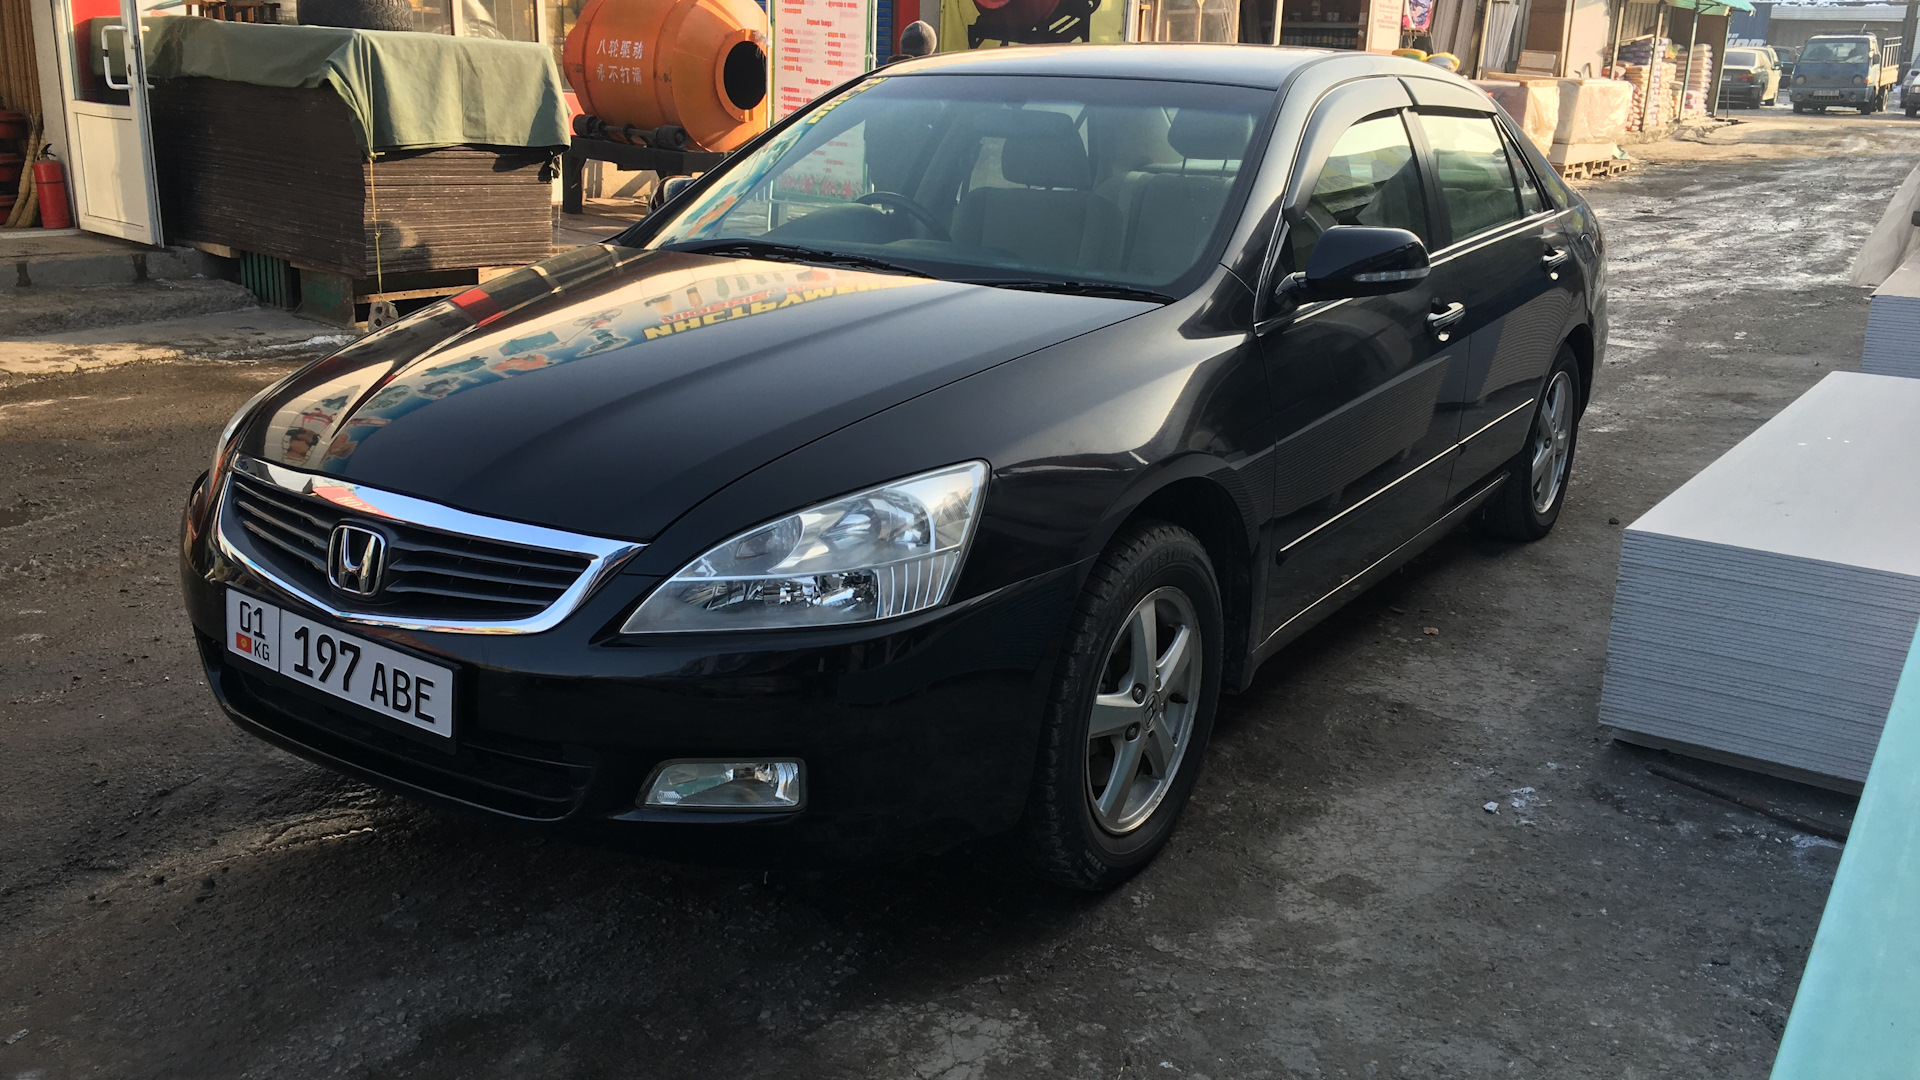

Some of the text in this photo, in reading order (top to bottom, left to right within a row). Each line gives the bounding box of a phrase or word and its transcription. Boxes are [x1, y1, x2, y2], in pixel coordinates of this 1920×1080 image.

[239, 600, 435, 724] 01 197 ABE
[254, 639, 270, 662] KG
